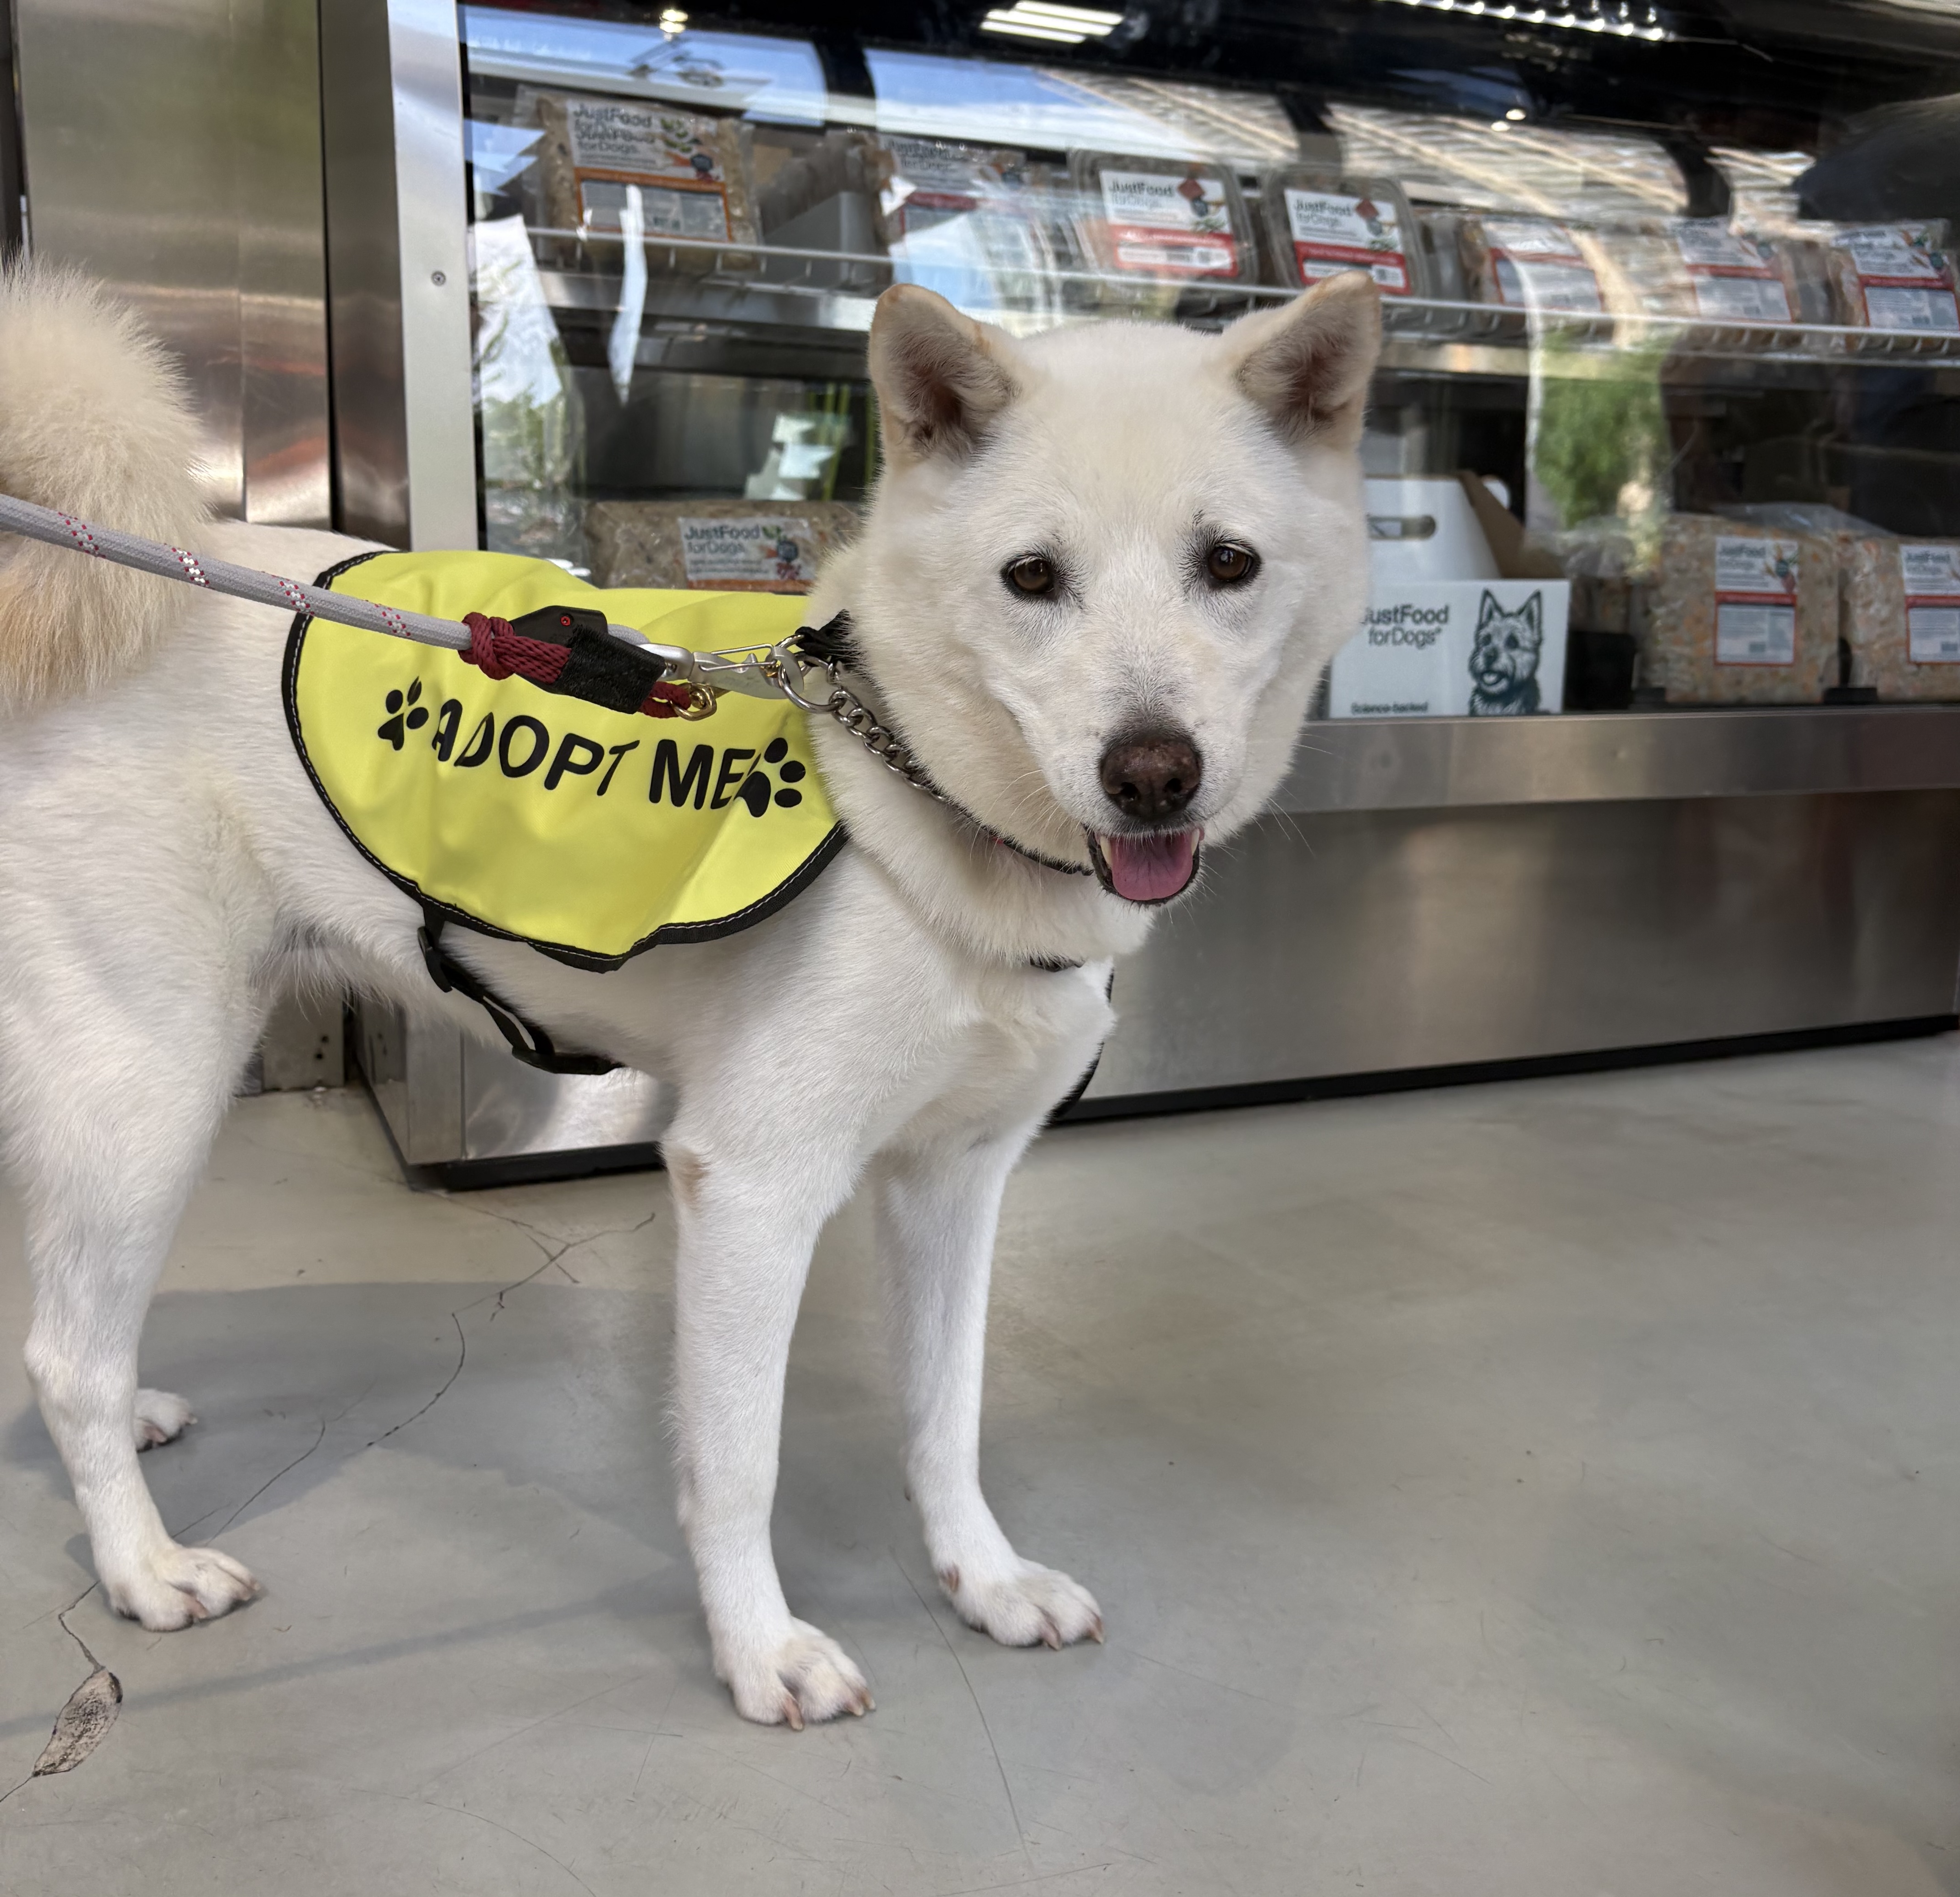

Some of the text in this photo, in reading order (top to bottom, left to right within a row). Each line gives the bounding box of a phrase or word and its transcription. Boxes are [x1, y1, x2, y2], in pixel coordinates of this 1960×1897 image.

[1108, 181, 1175, 197] JustFood
[1292, 199, 1353, 216] JustFood
[684, 524, 760, 540] JustFood
[431, 699, 756, 810] ADOPT ME
